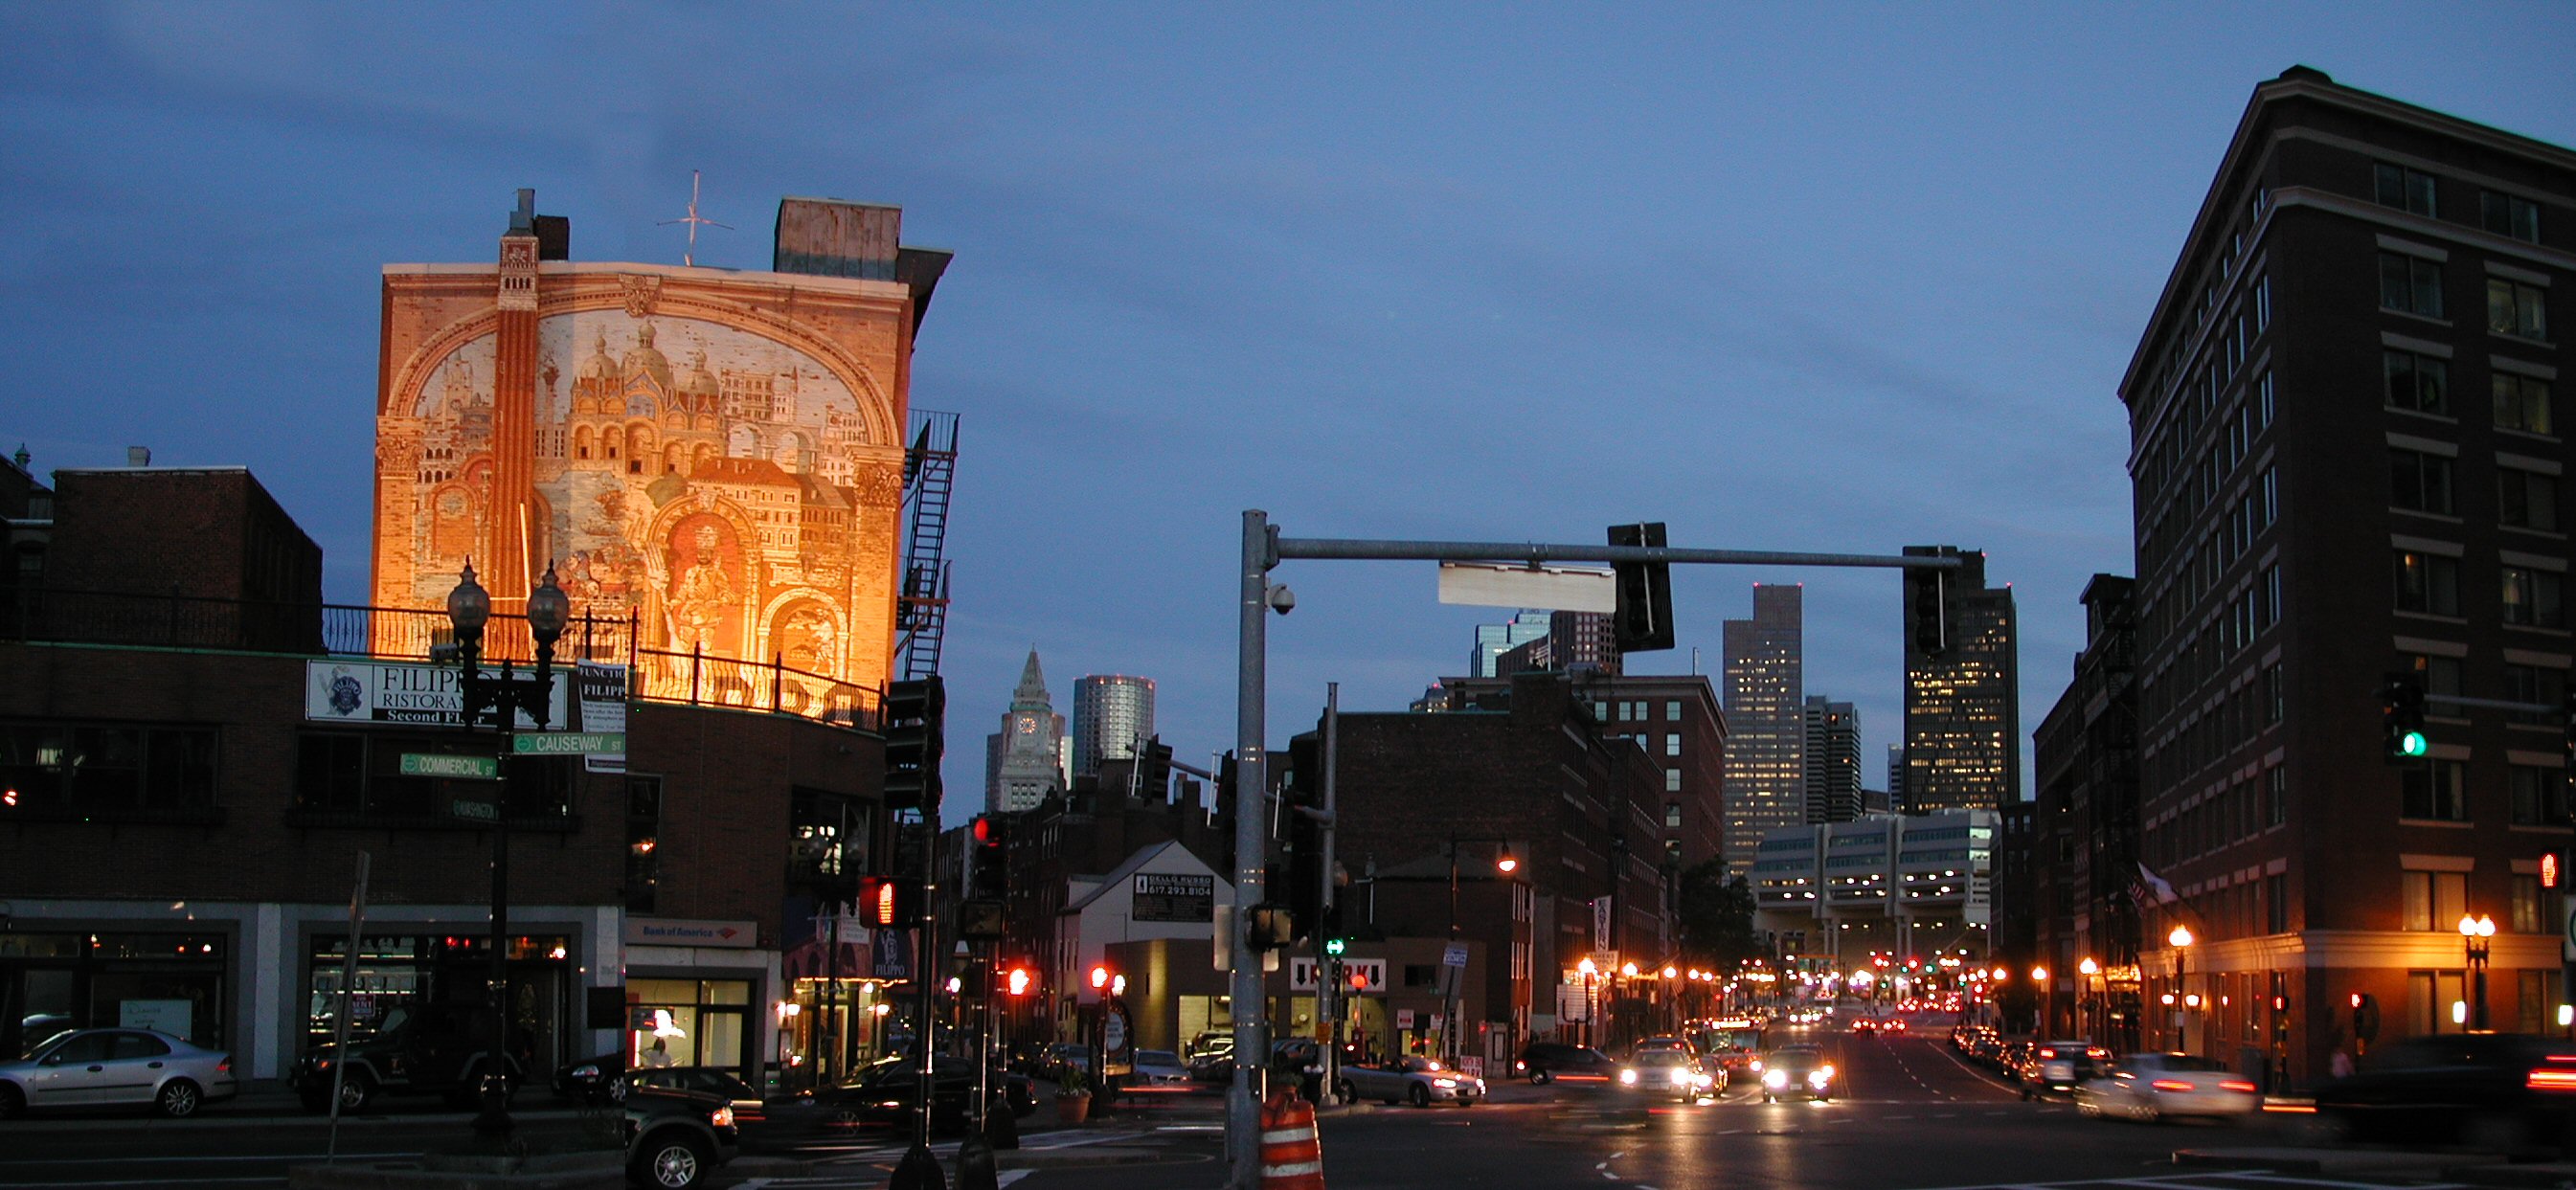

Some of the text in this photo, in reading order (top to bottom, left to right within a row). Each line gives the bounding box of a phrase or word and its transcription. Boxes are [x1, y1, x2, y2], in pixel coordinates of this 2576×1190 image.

[387, 709, 440, 723] Second
[536, 736, 621, 752] CAUSEWAY ST
[419, 756, 494, 775] COMMERCIAL ST
[644, 926, 666, 935] Bank
[676, 927, 713, 937] America
